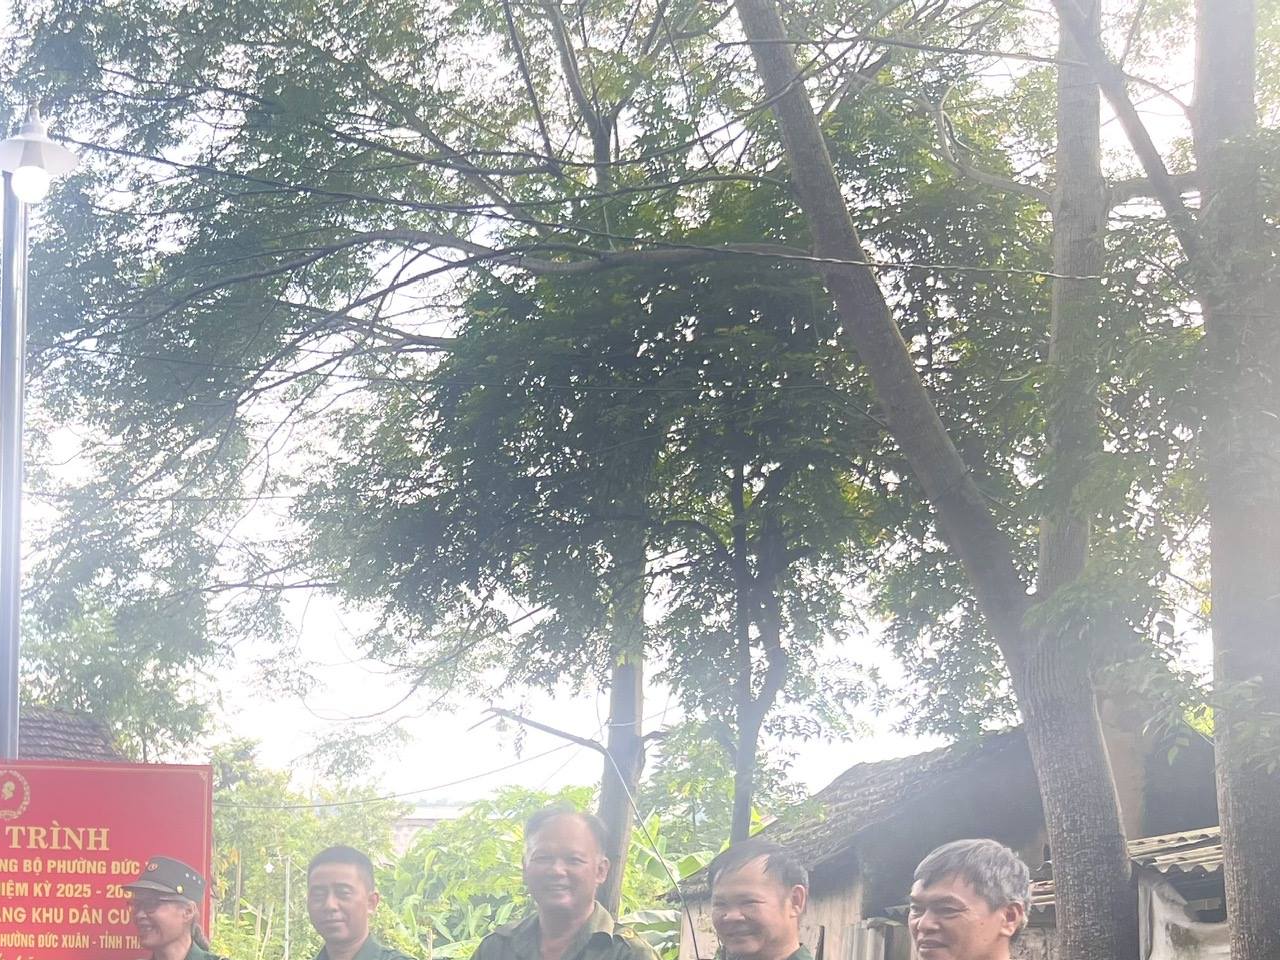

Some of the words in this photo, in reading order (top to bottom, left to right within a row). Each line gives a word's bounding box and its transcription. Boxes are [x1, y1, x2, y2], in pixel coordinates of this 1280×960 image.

[5, 820, 110, 850] TRÌNH
[23, 857, 42, 876] BỘ
[47, 857, 106, 874] PHƯỜNG
[111, 858, 140, 875] ĐỨC
[33, 881, 52, 897] KỲ
[56, 884, 91, 898] 2025
[106, 884, 135, 898] 203
[31, 907, 64, 923] KHU
[69, 904, 103, 924] DÂN
[107, 907, 136, 925] CƯ
[37, 931, 58, 948] ĐỨC
[61, 933, 90, 949] XUÂN
[99, 931, 123, 949] TỈNH
